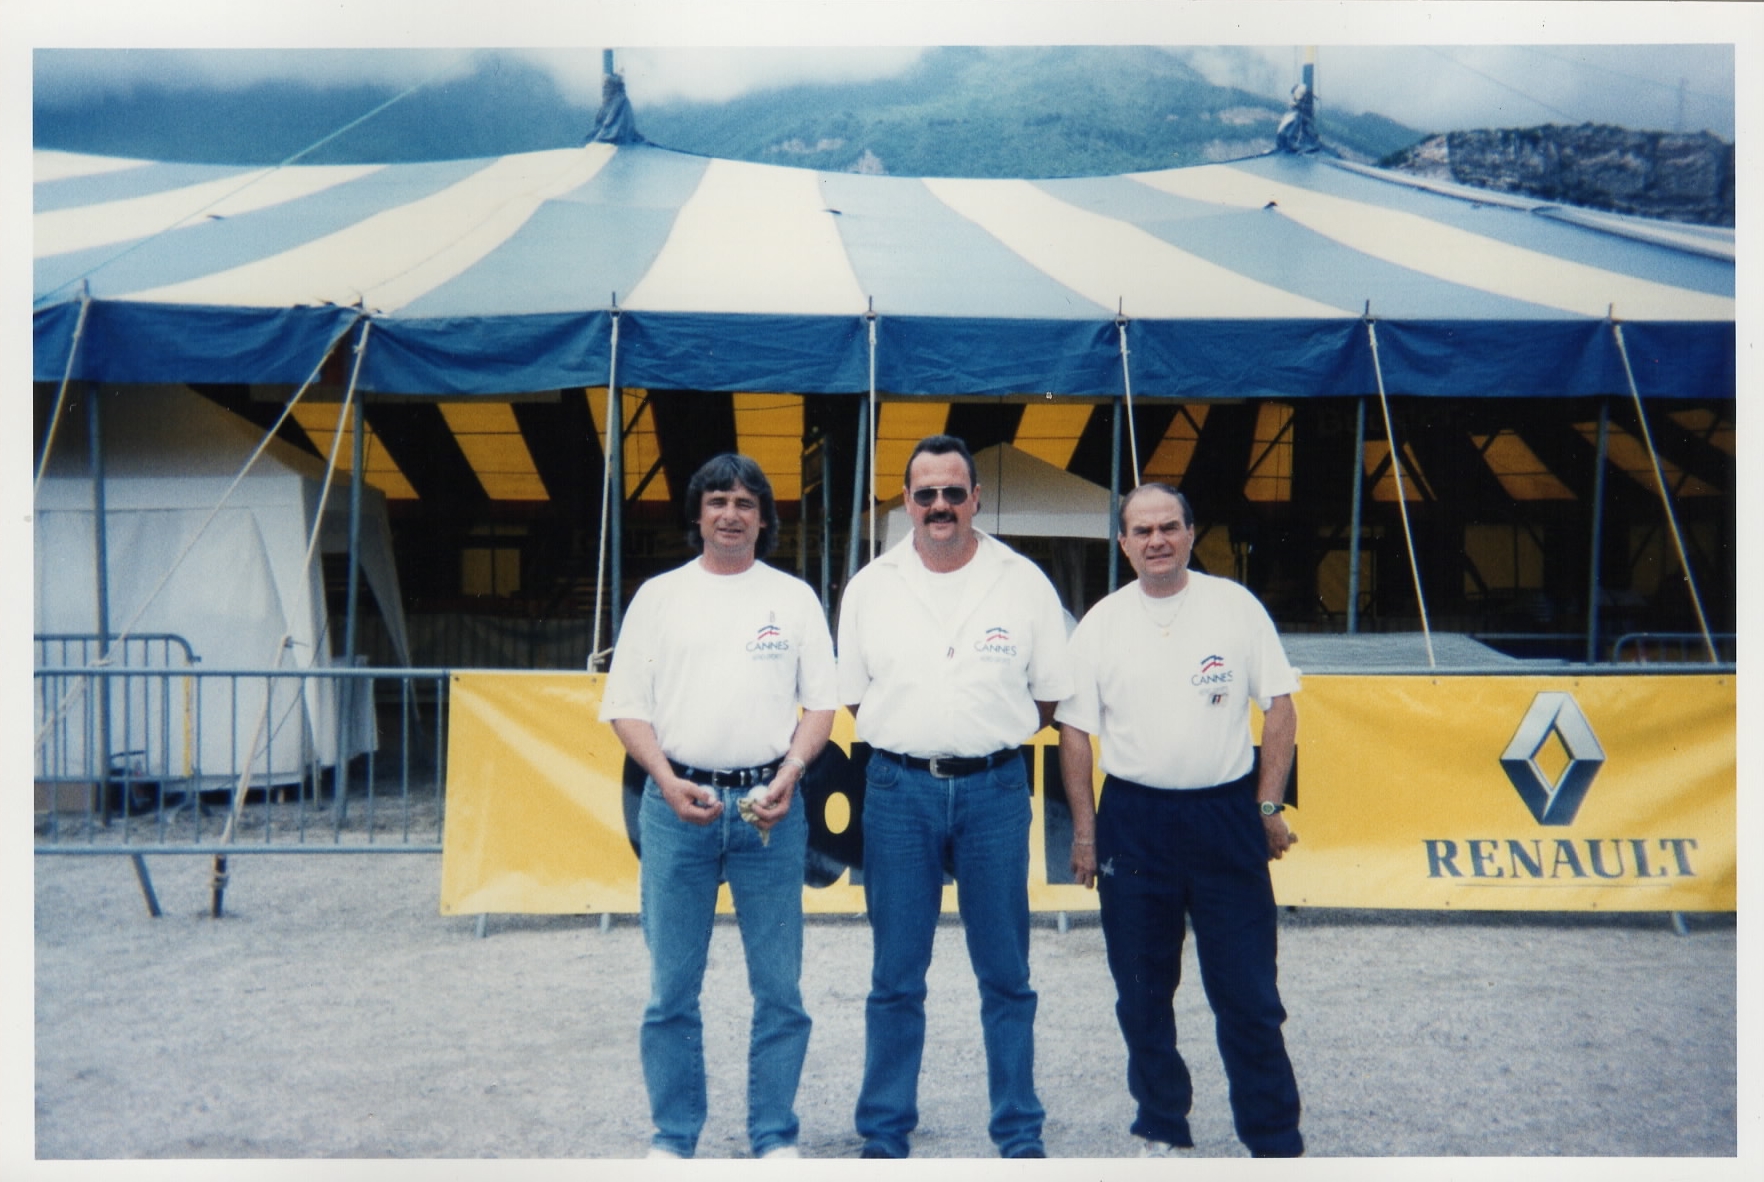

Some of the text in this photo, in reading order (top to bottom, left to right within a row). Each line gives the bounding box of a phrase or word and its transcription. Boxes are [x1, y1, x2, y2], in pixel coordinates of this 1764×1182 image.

[745, 639, 789, 652] CANNES
[973, 640, 1017, 657] CANNES
[1191, 669, 1234, 686] CANNES
[1422, 838, 1698, 878] RENAULT
